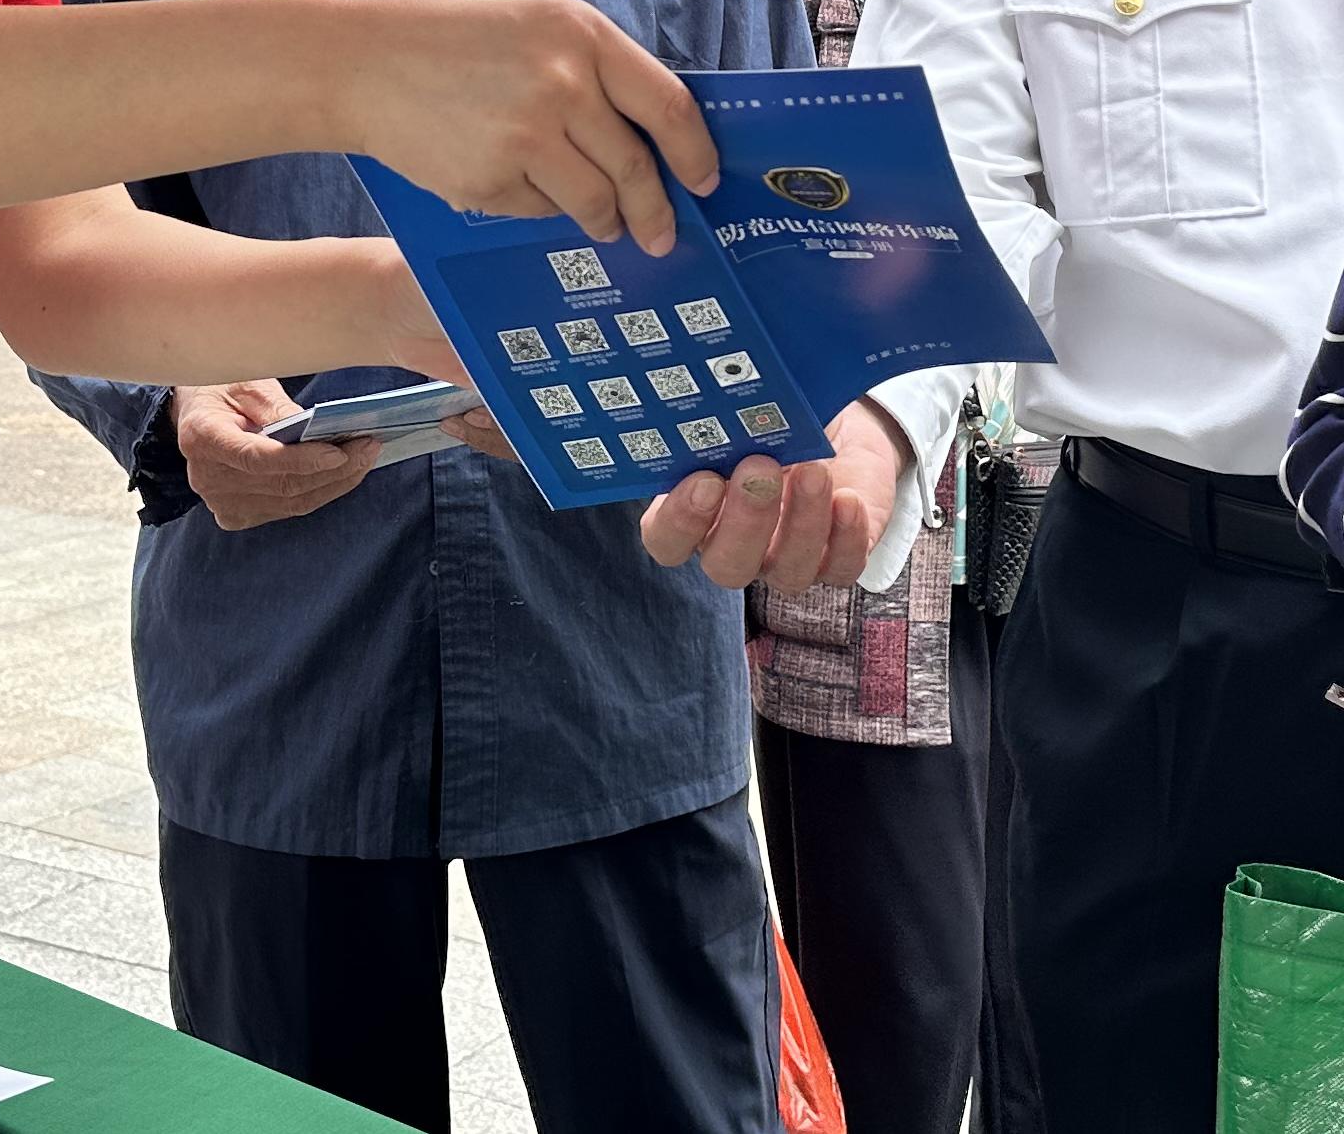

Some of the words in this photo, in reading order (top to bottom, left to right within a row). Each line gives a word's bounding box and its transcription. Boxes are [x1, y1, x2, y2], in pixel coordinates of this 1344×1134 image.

[715, 217, 960, 248] 防范电信网络诈骗
